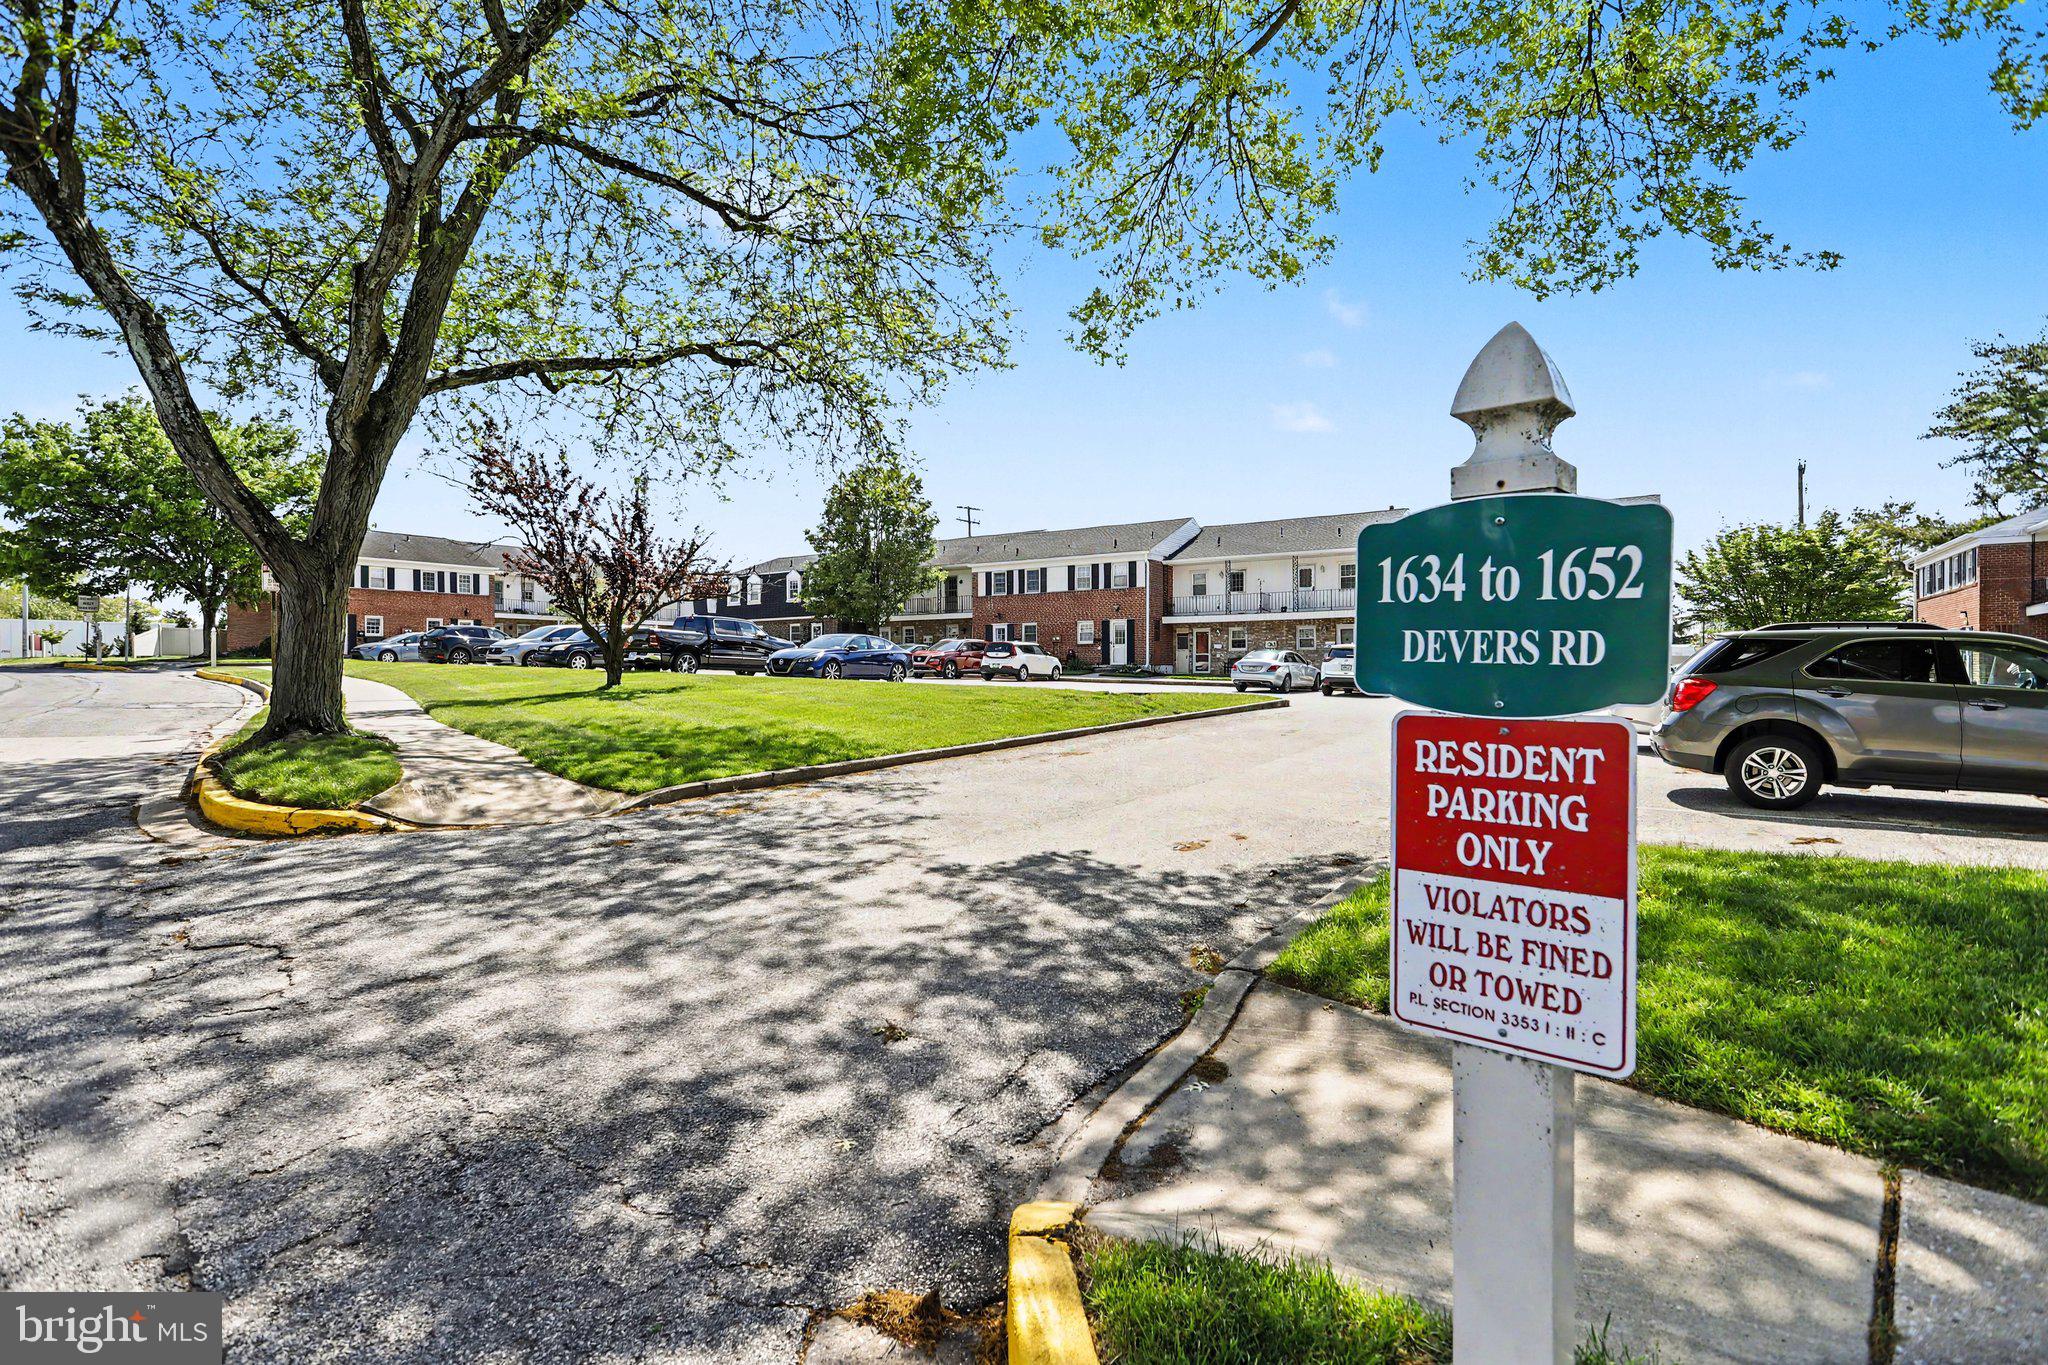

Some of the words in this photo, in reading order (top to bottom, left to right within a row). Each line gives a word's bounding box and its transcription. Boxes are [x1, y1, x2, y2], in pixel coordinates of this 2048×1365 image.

[1377, 553, 1465, 604] 1634
[1478, 555, 1520, 602] to
[1536, 545, 1644, 601] 1652
[1401, 629, 1540, 666] DEVERS
[1549, 629, 1606, 667] RD
[1414, 739, 1605, 784] RESIDENT
[1426, 783, 1589, 833] PARKING
[1456, 832, 1554, 876] ONLY
[1424, 884, 1592, 935] VIOLATORS
[1405, 918, 1470, 956] WILL
[1476, 930, 1513, 964] BE
[1521, 938, 1613, 980] FINED
[1428, 961, 1468, 993] OR
[1473, 968, 1583, 1016] TOWED
[1432, 996, 1496, 1023] SECTION
[1501, 1012, 1540, 1032] 3353
